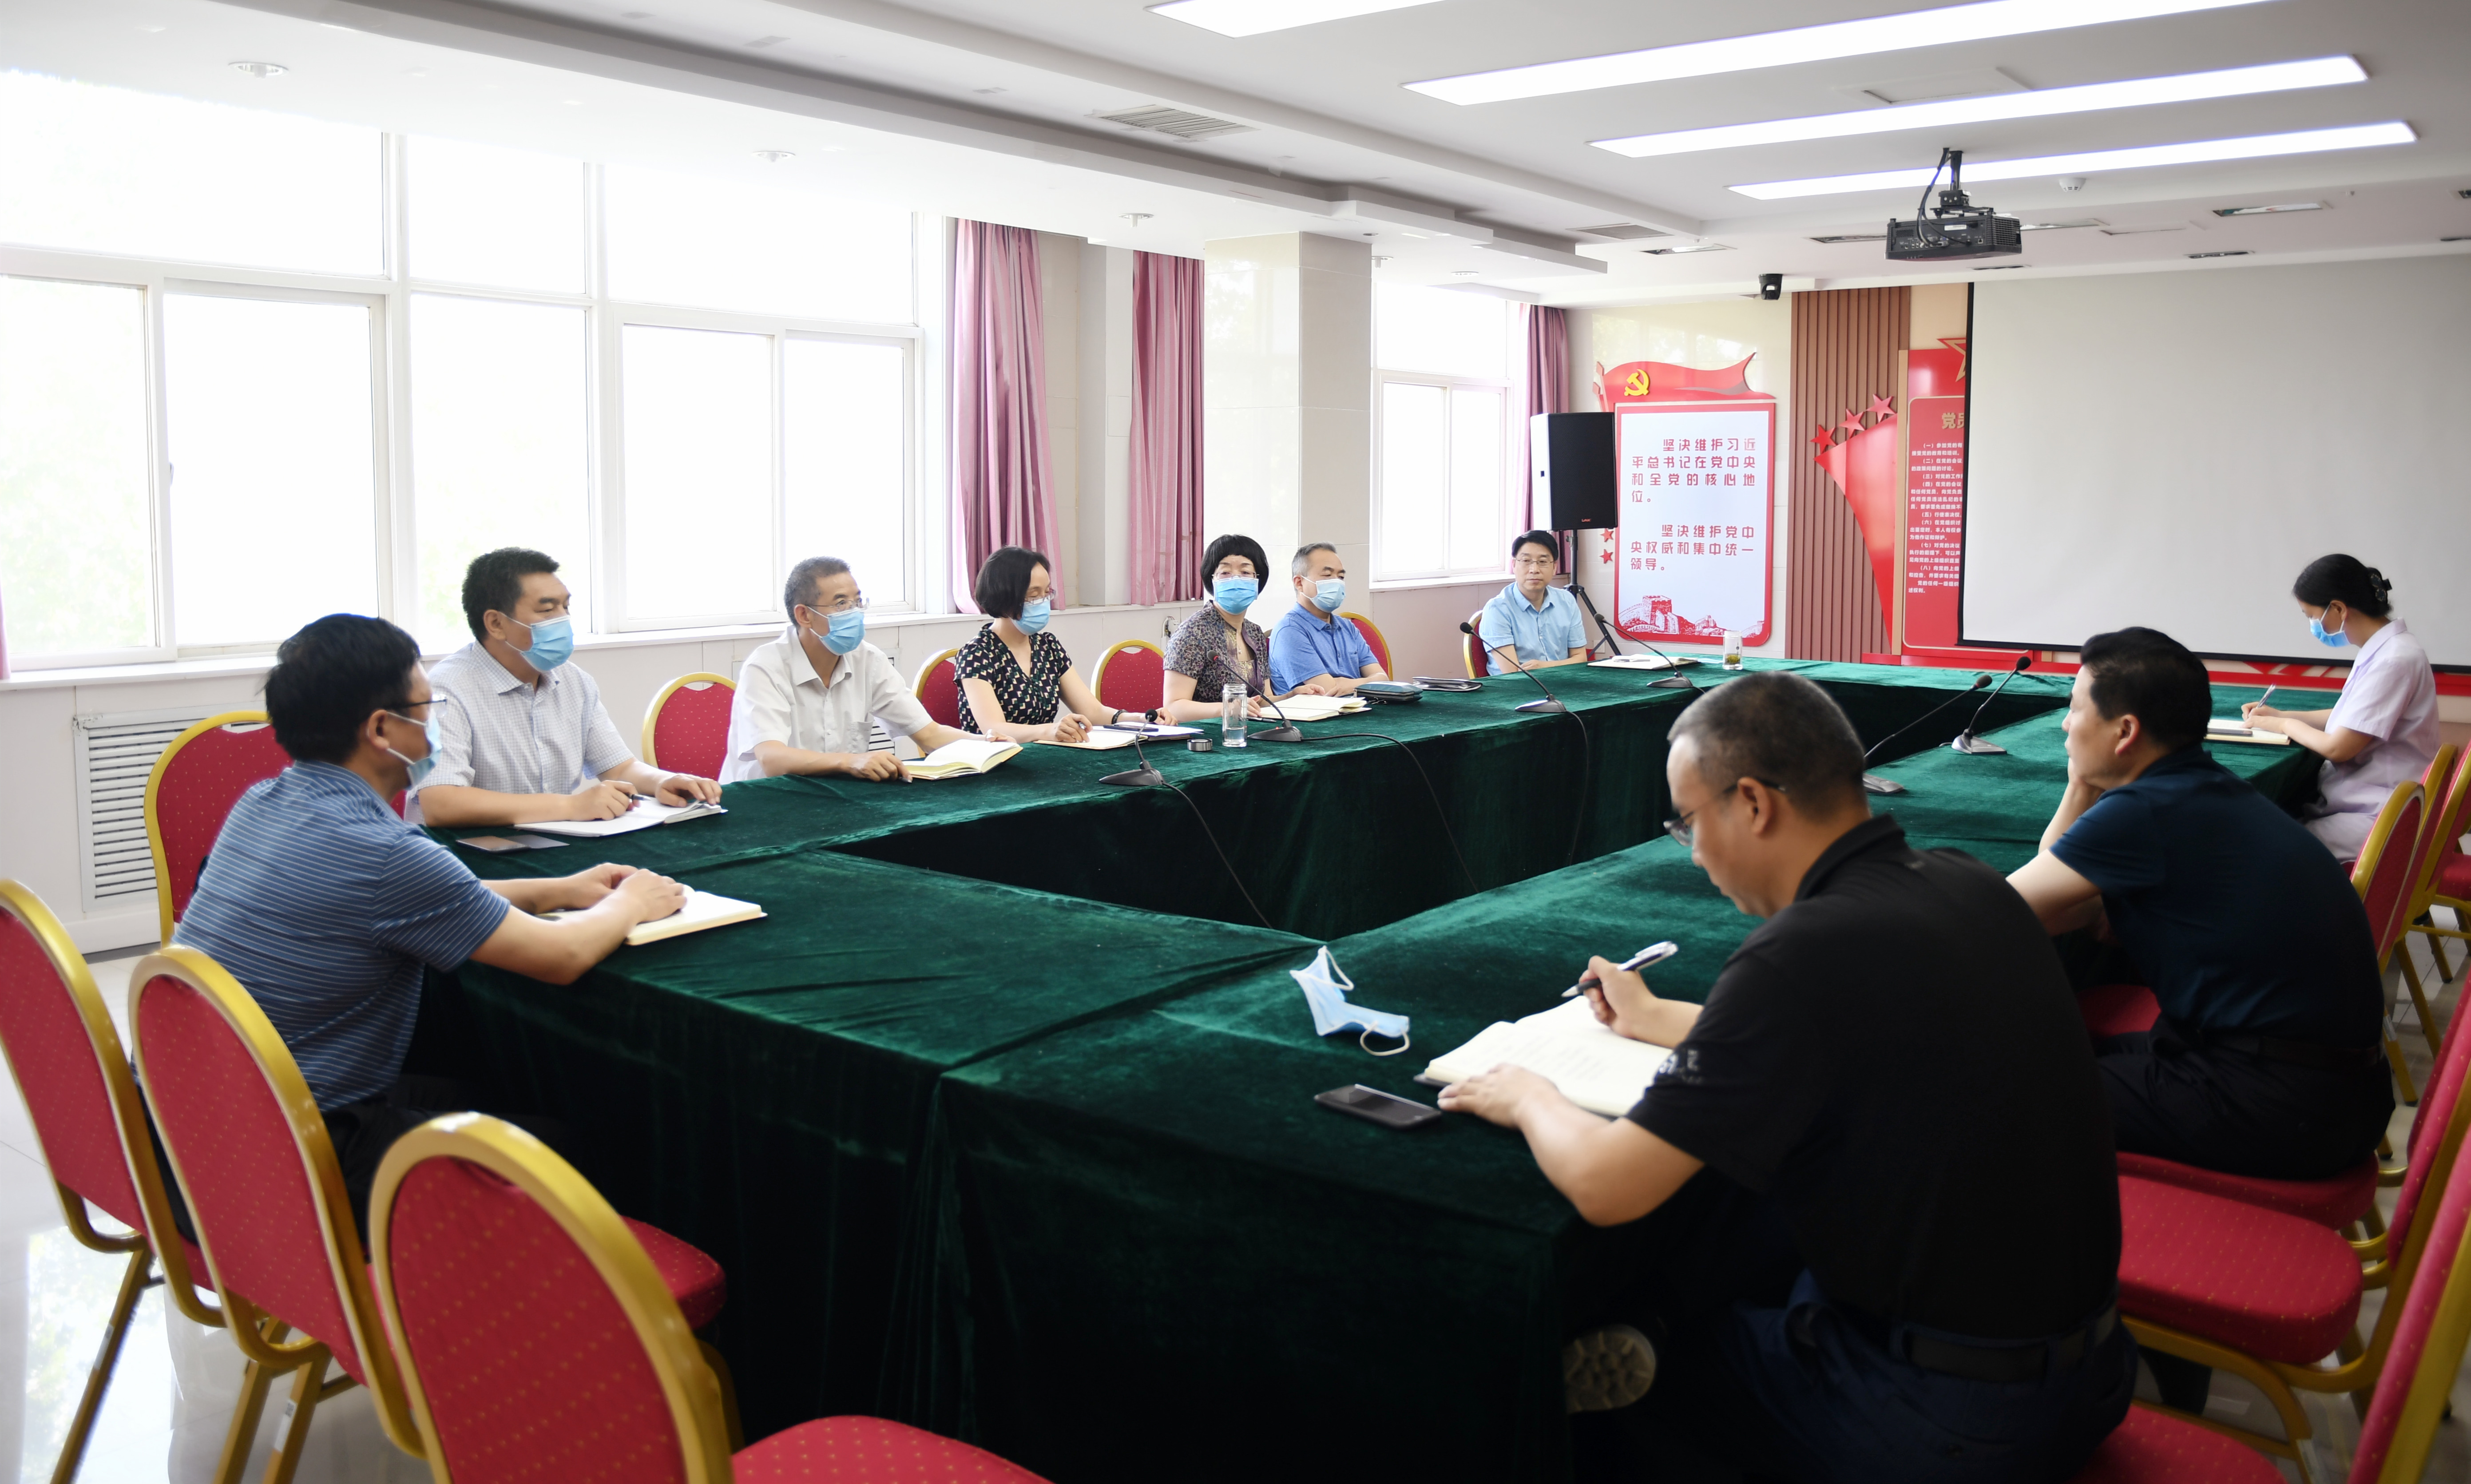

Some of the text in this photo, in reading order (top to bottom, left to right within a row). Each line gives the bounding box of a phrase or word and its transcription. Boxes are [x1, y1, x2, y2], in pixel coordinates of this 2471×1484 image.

[1663, 438, 1755, 451] 坚决维护习近
[1632, 456, 1755, 468] 平总书记在党中央
[1632, 473, 1754, 486] 和全党的核心地
[1632, 491, 1651, 502] 位。
[1662, 524, 1753, 538] 坚决维护党中
[1631, 541, 1753, 556] 央权威和集中统一
[1631, 558, 1664, 570] 领导。
